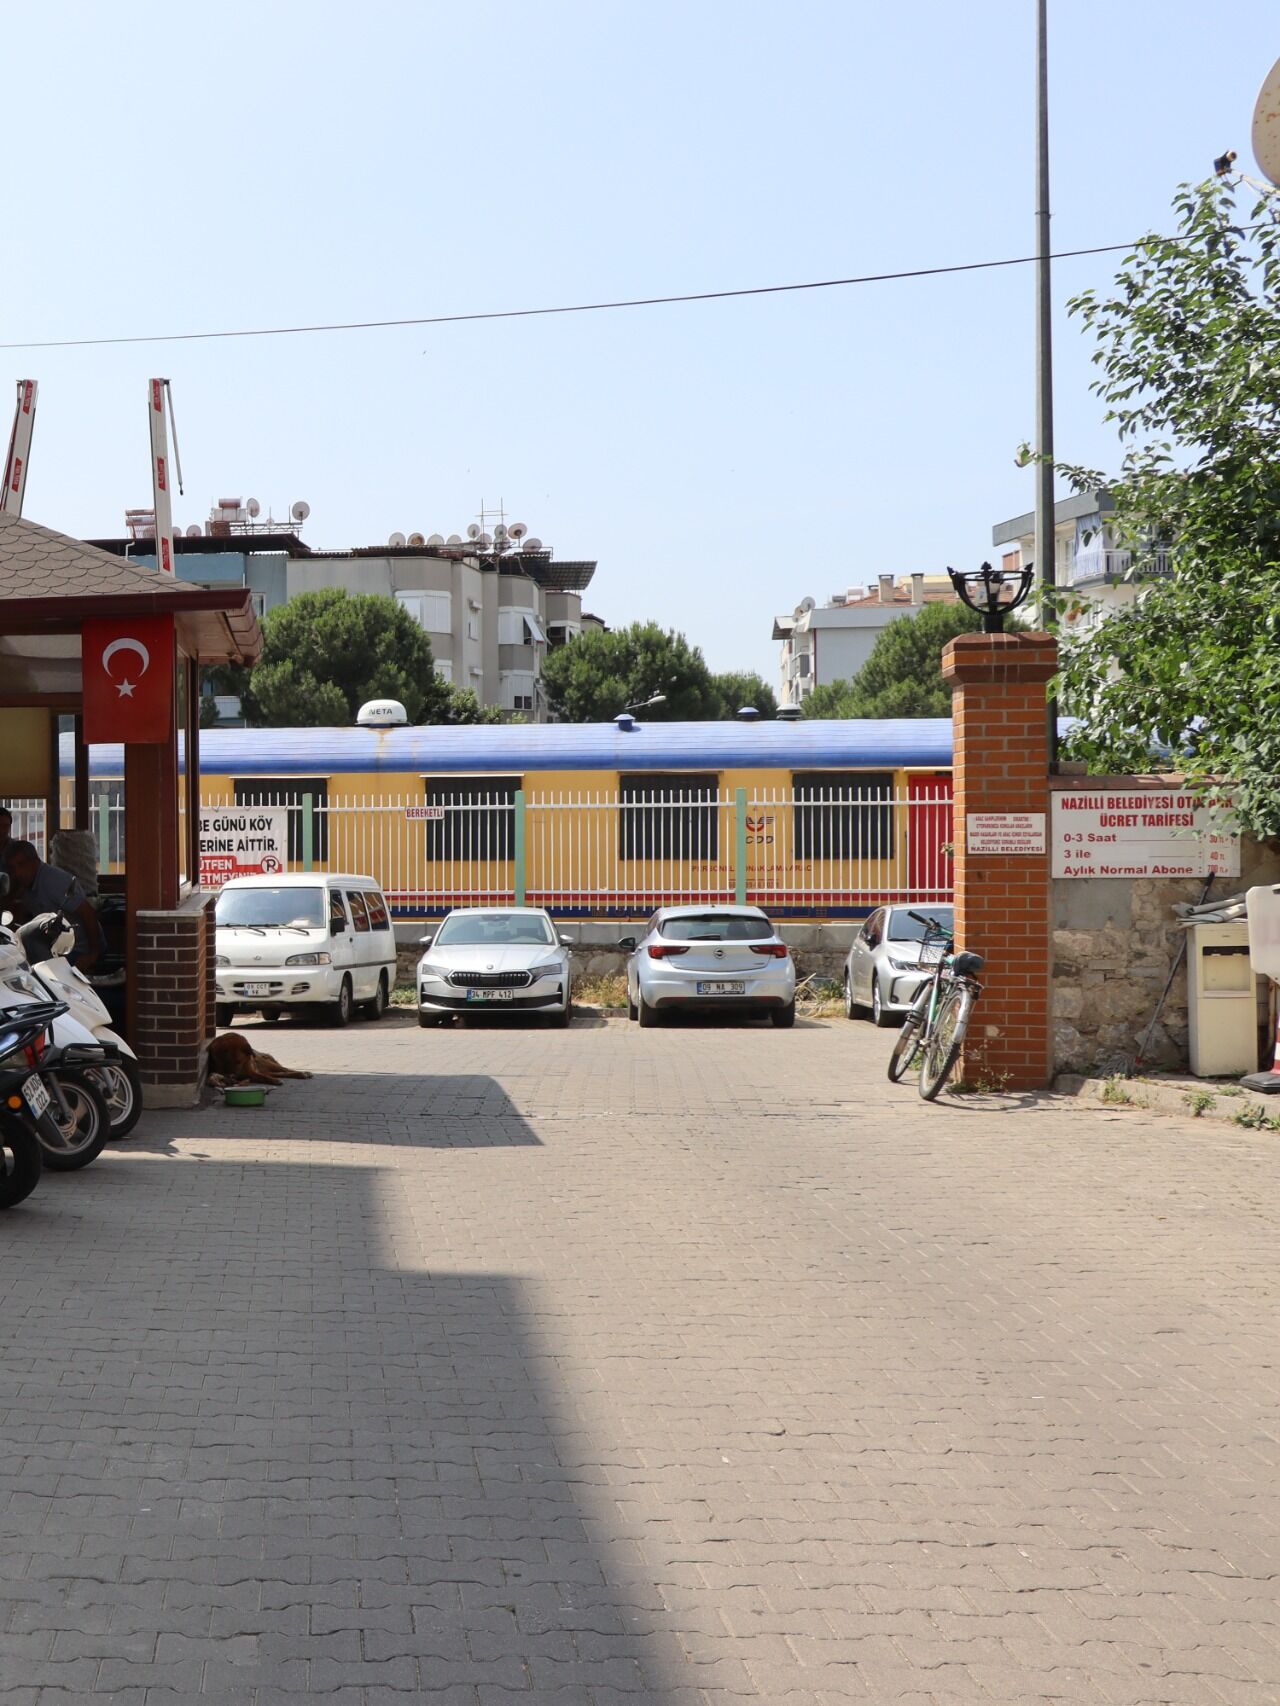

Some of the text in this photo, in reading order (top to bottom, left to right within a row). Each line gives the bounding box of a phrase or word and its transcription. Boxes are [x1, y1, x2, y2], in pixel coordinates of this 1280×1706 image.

[1061, 795, 1104, 809] NAZİLLİ
[1107, 794, 1173, 809] BELEDİYESİ
[213, 816, 246, 831] GÜNÜ
[250, 816, 273, 831] KÖY
[1100, 812, 1193, 827] ÜCRET TARİFESİ
[200, 836, 278, 852] ERİNE AİTTİR.
[745, 835, 774, 844] CDD
[1063, 833, 1083, 842] 0-3
[1087, 833, 1117, 842] Saat
[1063, 849, 1071, 858] 3
[1075, 849, 1091, 858] ile
[1063, 866, 1095, 876] Aylık
[1100, 865, 1147, 874] Normal
[1152, 865, 1193, 874] Abone
